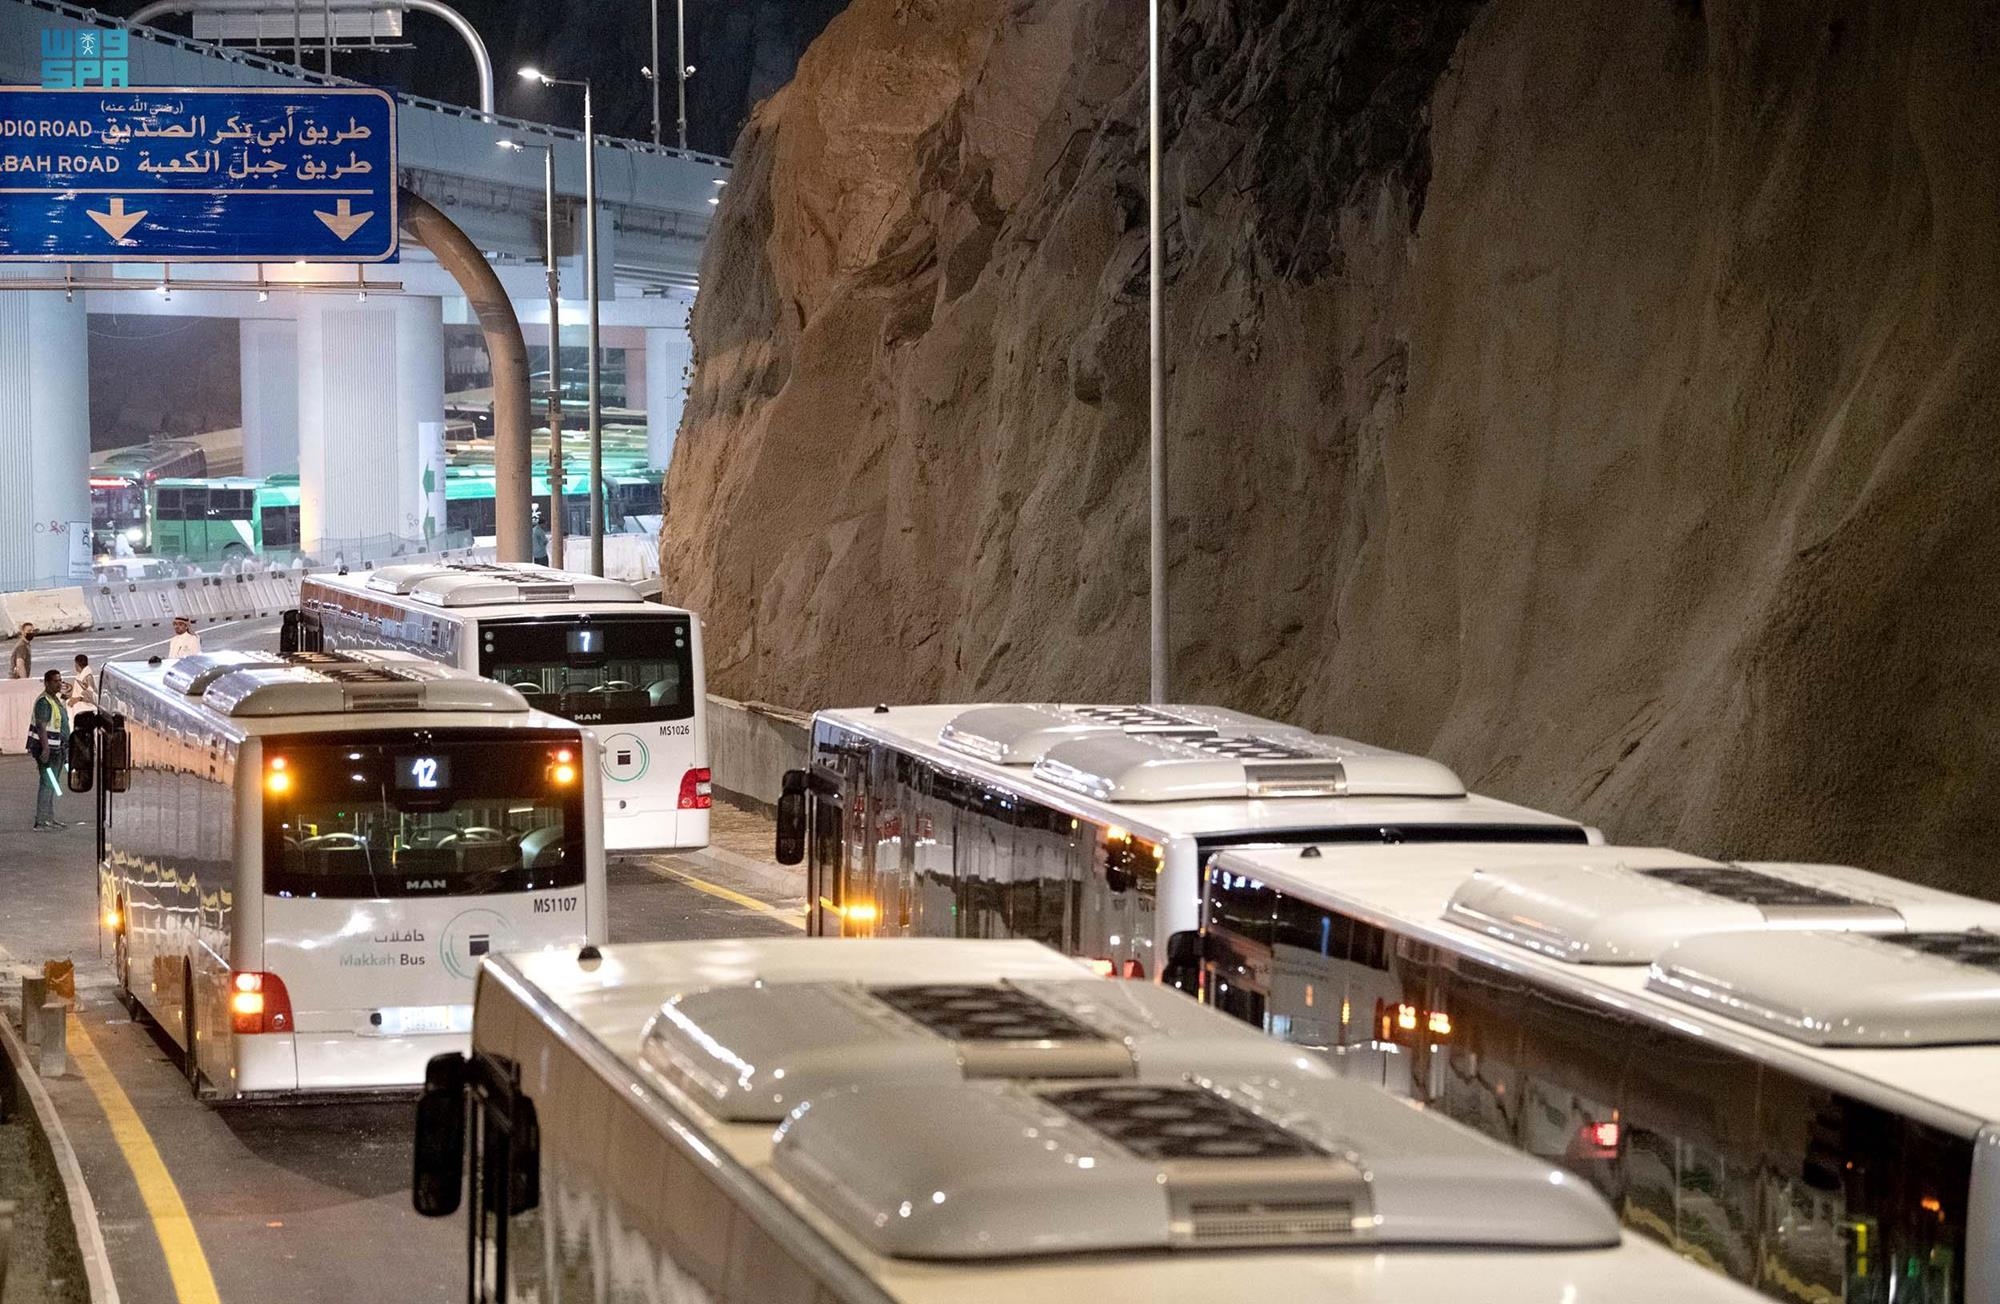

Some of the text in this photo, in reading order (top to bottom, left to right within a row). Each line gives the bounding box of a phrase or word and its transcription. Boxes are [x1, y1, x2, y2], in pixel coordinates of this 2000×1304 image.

[0, 119, 92, 138] DIQ ROAD
[100, 105, 372, 154] طريق أبي بكر الصديق
[0, 155, 120, 173] BAH ROAD
[137, 149, 373, 181] طريق جبل الكعبة
[579, 631, 591, 652] 7
[574, 713, 602, 721] MAN
[659, 725, 690, 736] MS1026
[412, 758, 437, 788] 12
[406, 879, 447, 890] MAN
[533, 897, 577, 913] MS1107
[400, 953, 426, 966] Bus
